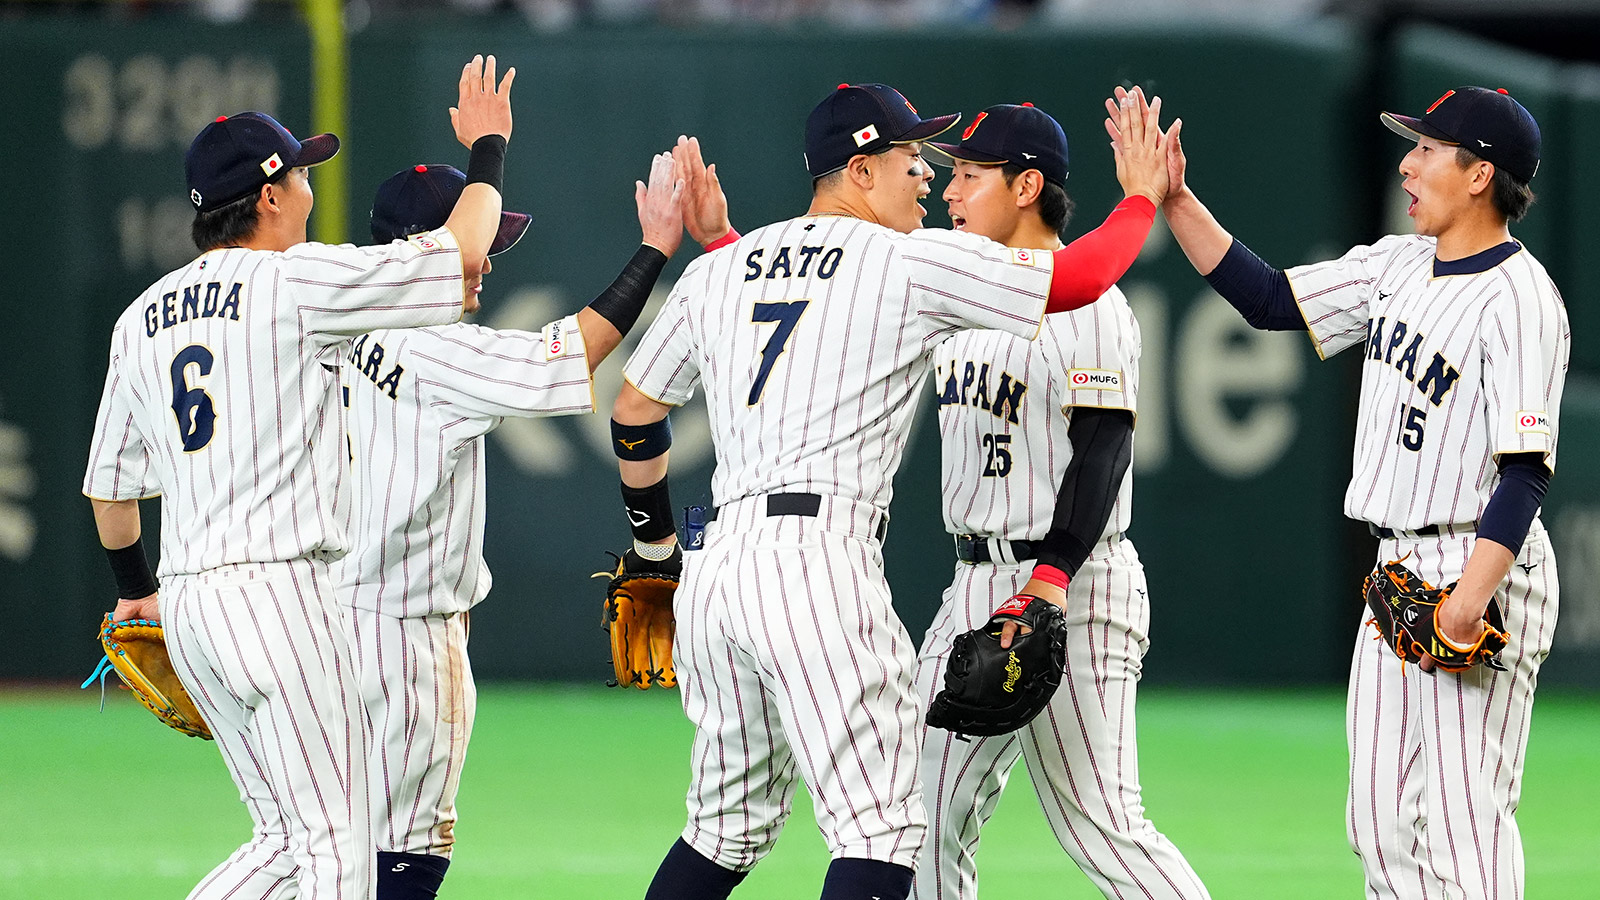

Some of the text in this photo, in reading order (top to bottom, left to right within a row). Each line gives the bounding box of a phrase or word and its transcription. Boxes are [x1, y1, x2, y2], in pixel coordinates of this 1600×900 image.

[744, 245, 845, 283] SATO
[144, 281, 243, 339] GENDA
[350, 333, 404, 401] ARA
[747, 299, 812, 408] 7
[1089, 374, 1118, 385] MUFG
[170, 343, 219, 455] 6
[937, 358, 1029, 427] APAN
[982, 433, 1014, 479] 25
